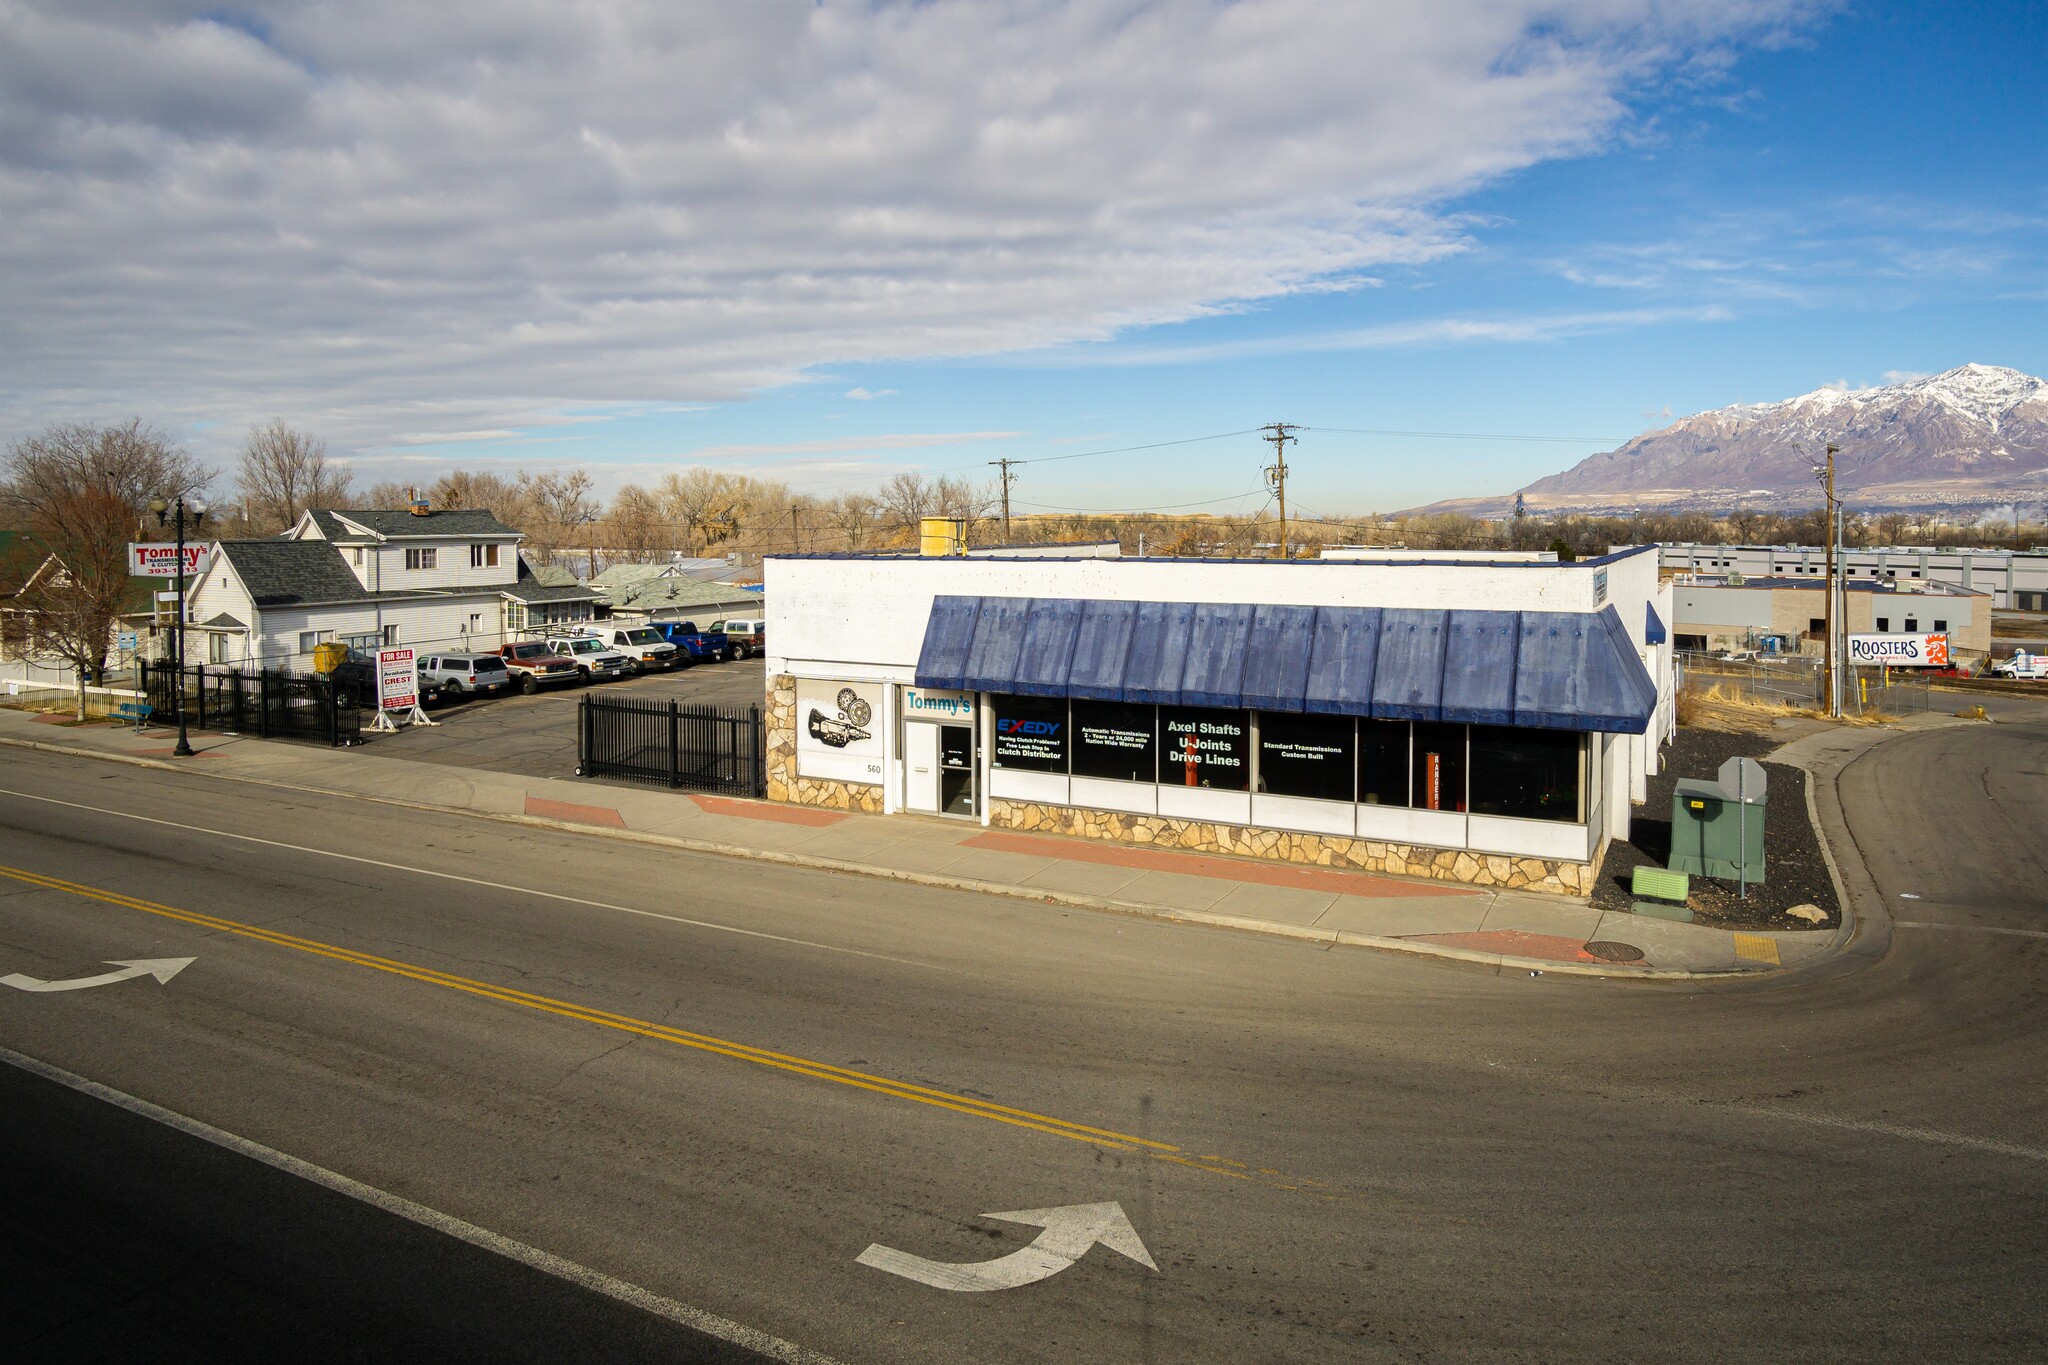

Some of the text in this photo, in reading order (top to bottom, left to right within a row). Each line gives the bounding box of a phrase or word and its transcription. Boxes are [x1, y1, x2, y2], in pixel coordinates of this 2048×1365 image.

[136, 545, 207, 566] Tommy's
[383, 651, 411, 661] FOR SALE
[1852, 640, 1918, 660] ROOSTERS
[384, 676, 411, 685] CREST
[907, 691, 971, 716] Tommy's
[997, 718, 1061, 735] EXEDY
[1081, 726, 1150, 738] Automatic Transmissions
[1167, 720, 1241, 736] Axel Shafts
[998, 735, 1017, 743] Having
[1033, 738, 1061, 746] Problems?
[1119, 741, 1145, 750] Warranty
[1178, 737, 1232, 751] U-Joints
[997, 747, 1062, 760] Clutch Distributor
[1263, 741, 1342, 754] Standard Transmissions
[1169, 750, 1241, 767] Drive Lines
[1281, 751, 1307, 759] Custom
[867, 764, 881, 774] 560
